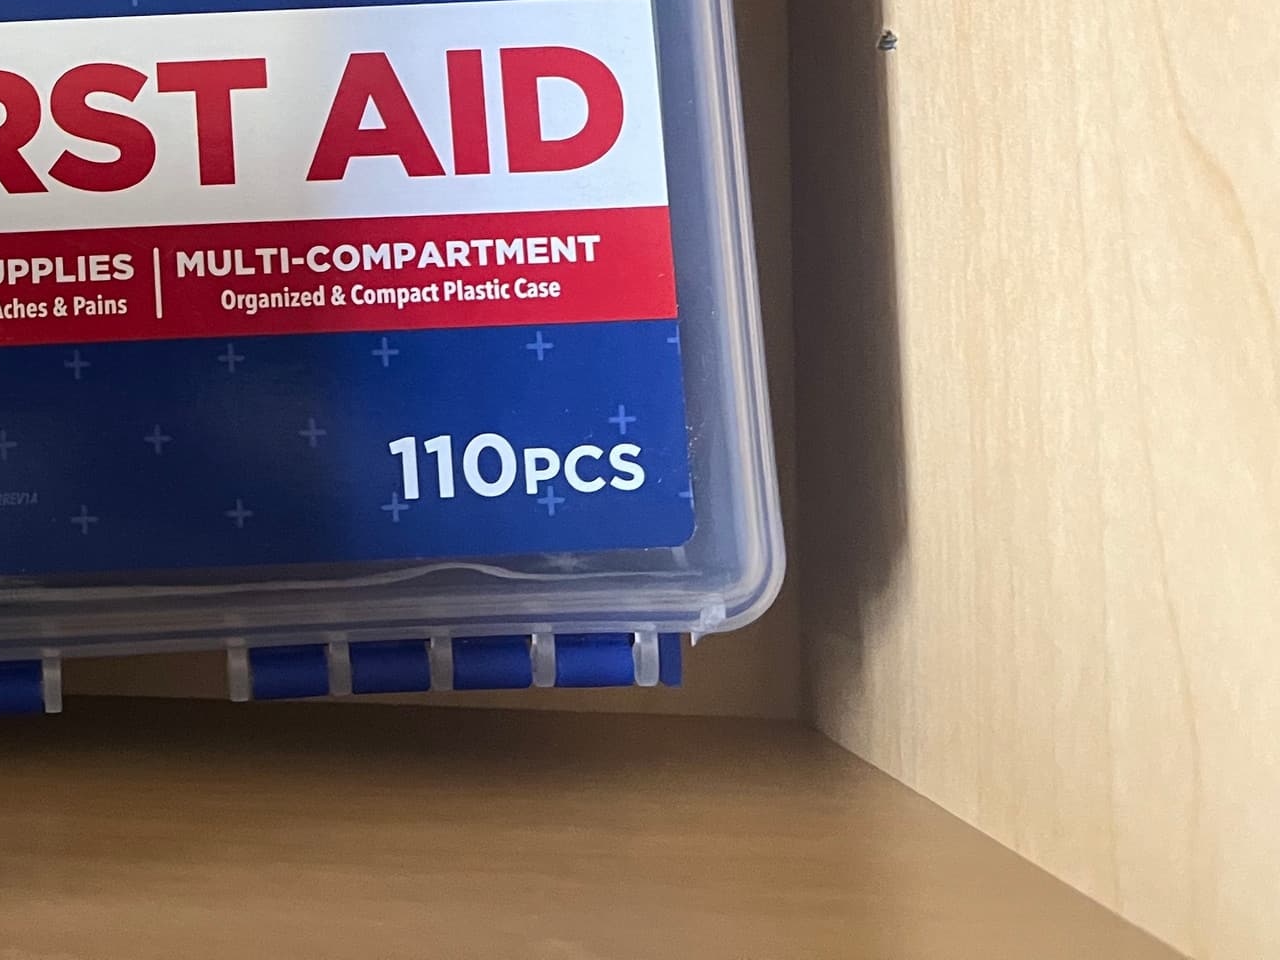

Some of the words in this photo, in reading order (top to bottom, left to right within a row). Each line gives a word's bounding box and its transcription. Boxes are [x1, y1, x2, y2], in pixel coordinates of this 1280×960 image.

[305, 46, 624, 181] AID
[177, 234, 600, 278] MULTI-COMPARTMENT
[53, 296, 69, 316] &
[74, 293, 127, 316] Pains
[222, 283, 325, 314] Organized
[331, 286, 346, 305] &
[351, 282, 439, 309] Compact
[445, 278, 509, 301] Plastic
[514, 277, 560, 299] Case
